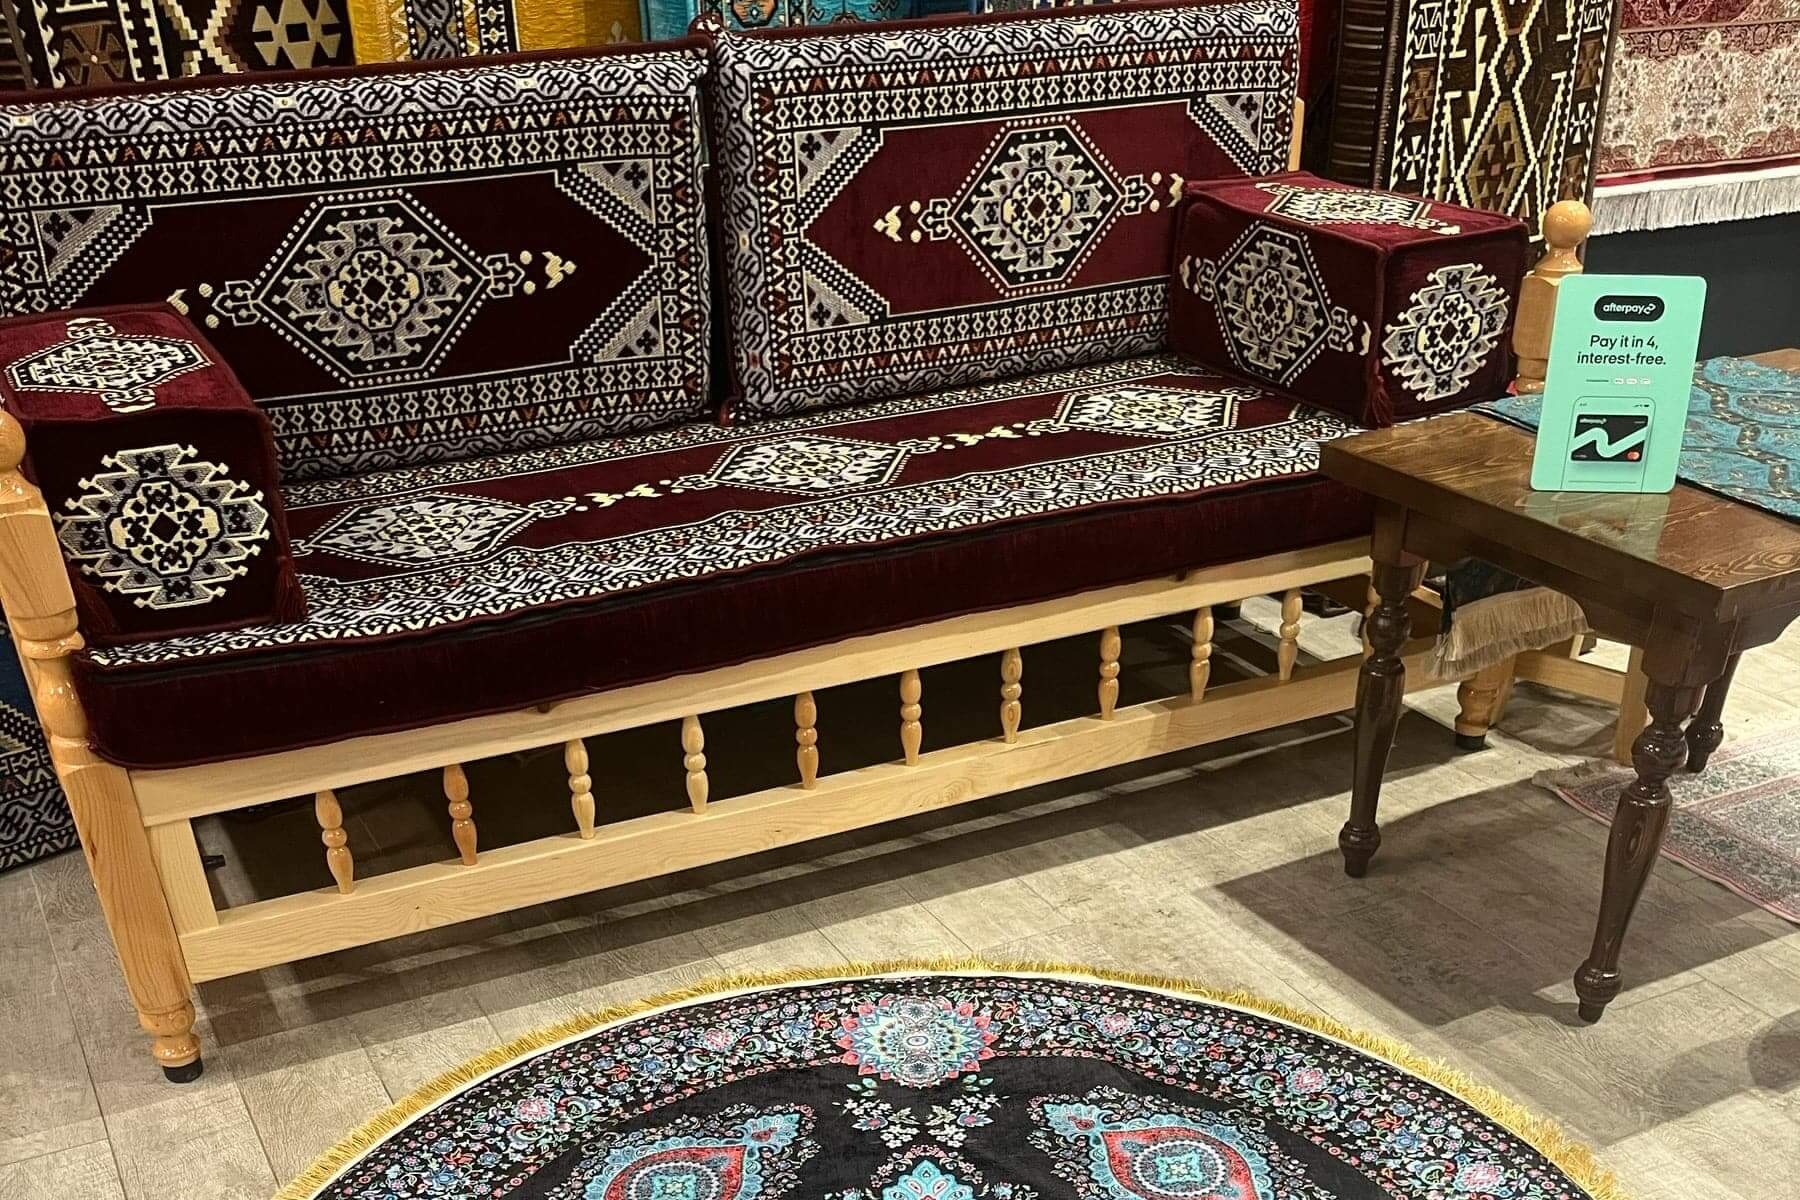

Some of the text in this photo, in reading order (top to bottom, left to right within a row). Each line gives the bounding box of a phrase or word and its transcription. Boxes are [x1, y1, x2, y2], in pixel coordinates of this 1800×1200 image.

[1602, 302, 1644, 315] afterpay
[1590, 334, 1658, 350] Pay it in 4,
[1576, 351, 1667, 365] interest-free.
